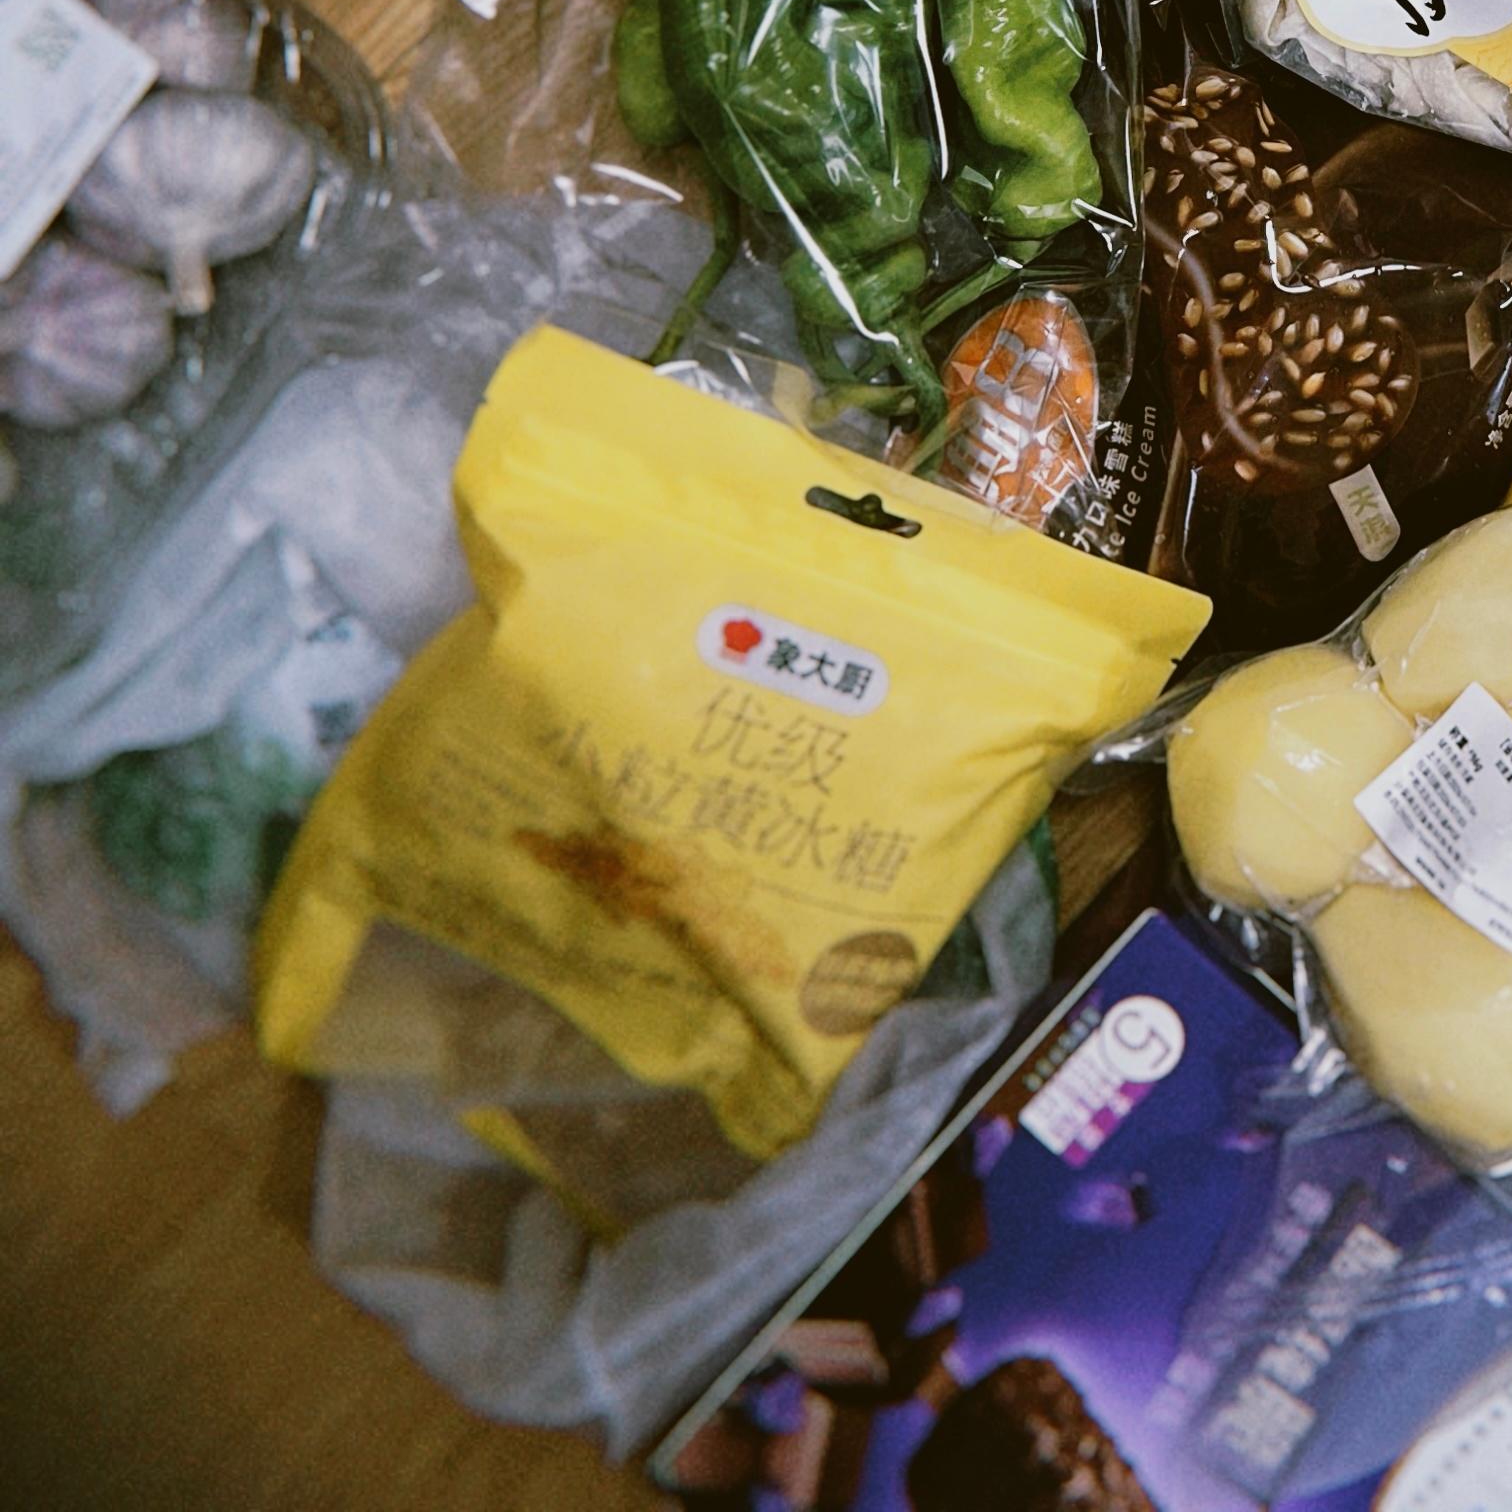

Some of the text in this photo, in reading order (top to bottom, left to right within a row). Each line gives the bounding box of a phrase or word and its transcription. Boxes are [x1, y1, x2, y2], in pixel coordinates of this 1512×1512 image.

[1062, 419, 1135, 554] 力口味雪糕
[1116, 487, 1140, 526] Ice
[1131, 404, 1158, 482] Cream
[766, 635, 874, 701] 象大厨
[692, 684, 851, 798] 优级
